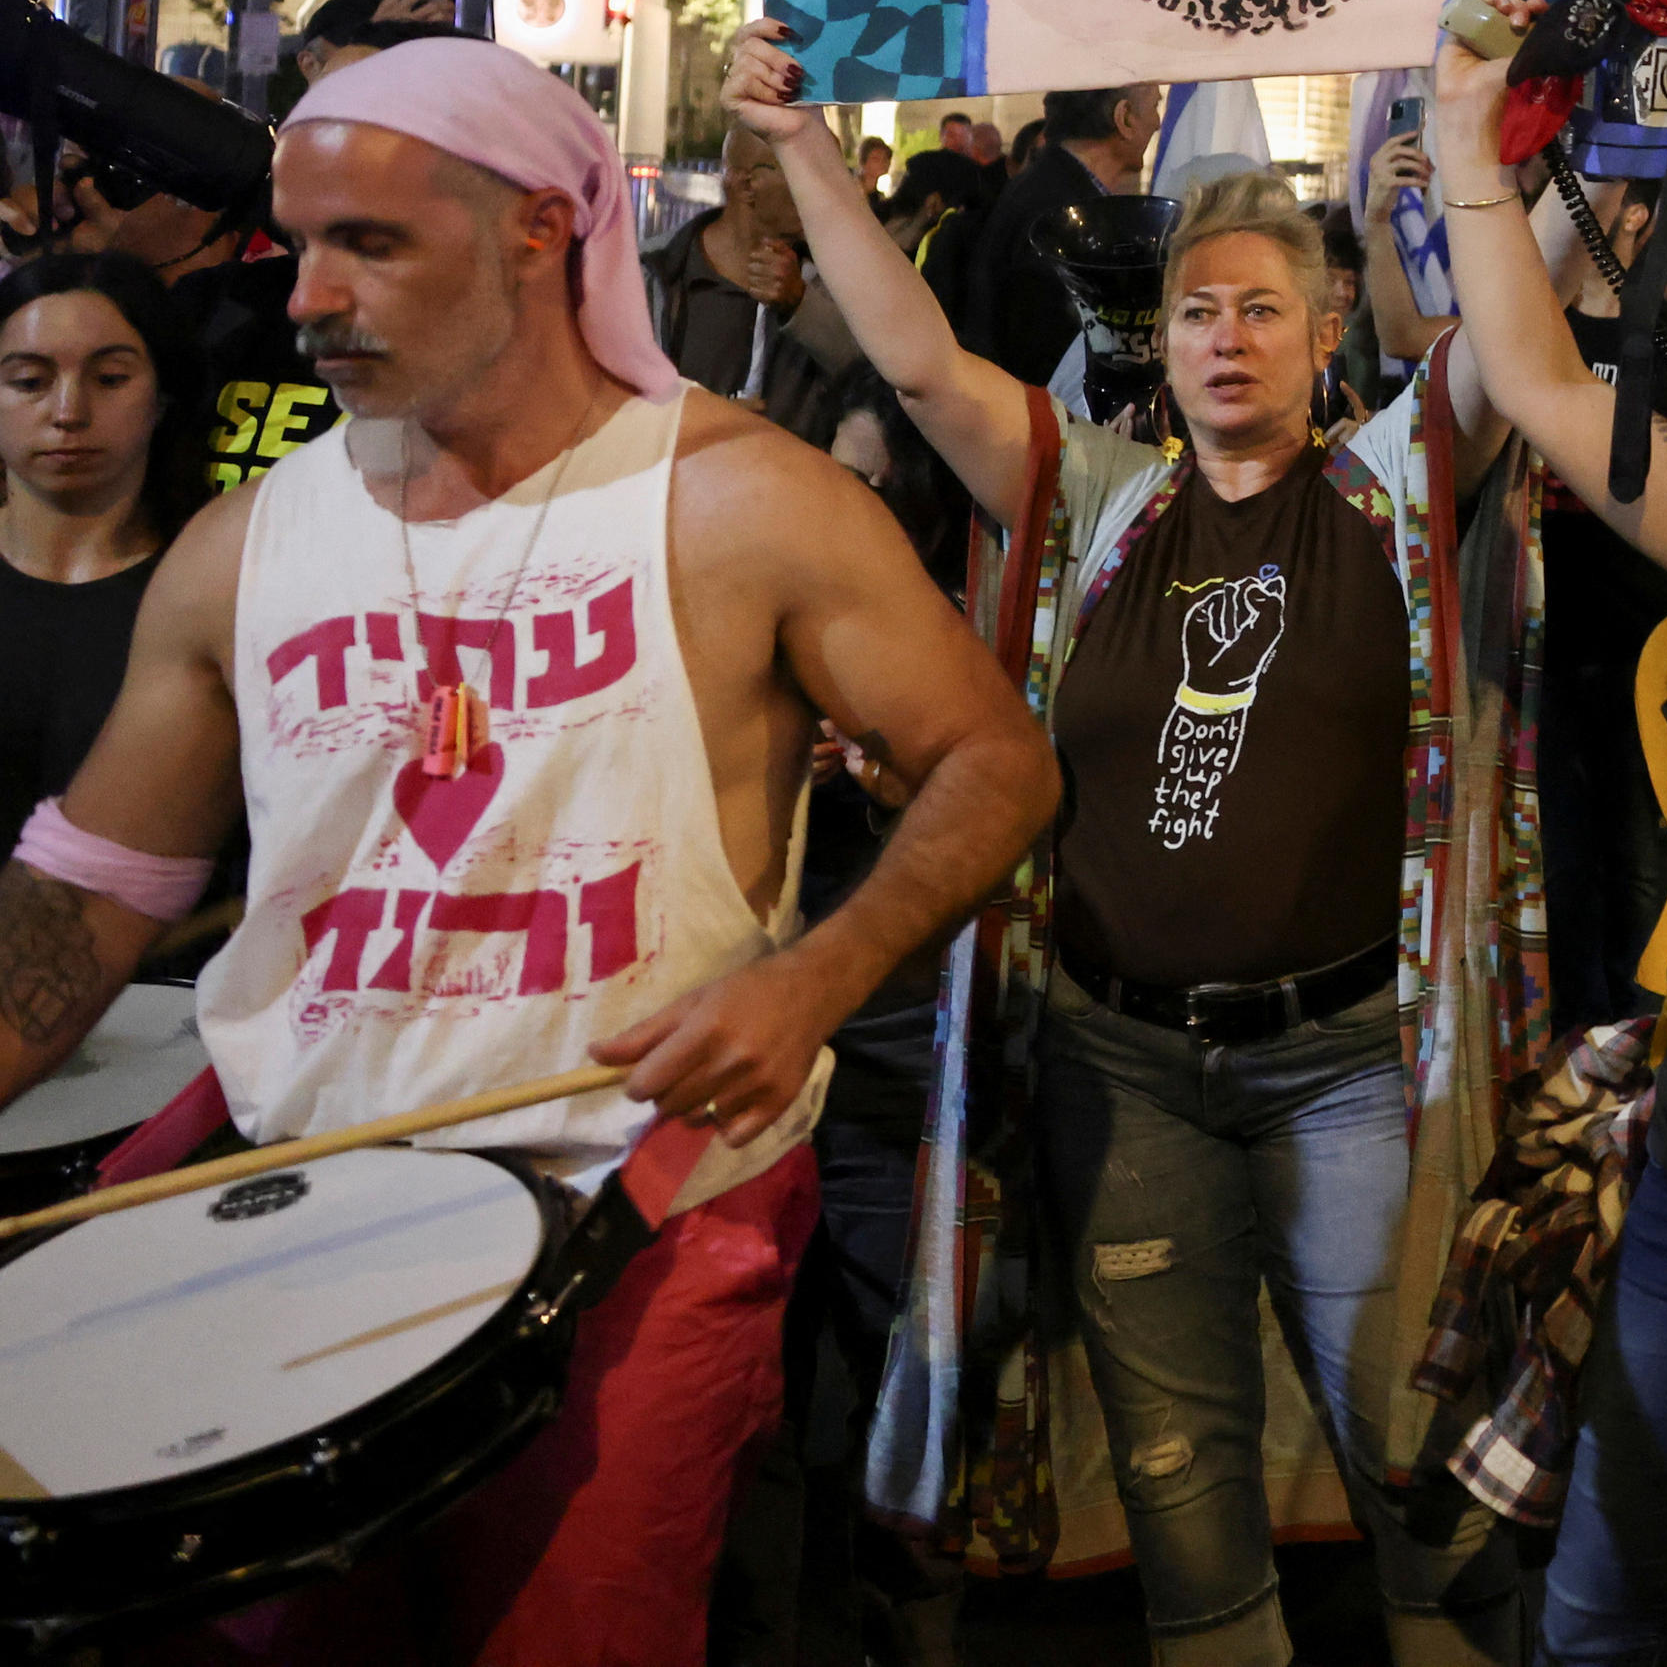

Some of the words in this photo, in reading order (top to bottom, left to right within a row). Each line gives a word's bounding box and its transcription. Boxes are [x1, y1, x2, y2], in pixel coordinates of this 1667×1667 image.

[265, 575, 638, 713] עתיד
[1174, 715, 1237, 741] Don't
[1170, 740, 1229, 774] give
[1154, 777, 1201, 809] the
[1185, 768, 1222, 799] up
[1148, 799, 1220, 850] fight
[301, 859, 642, 997] ורוד
